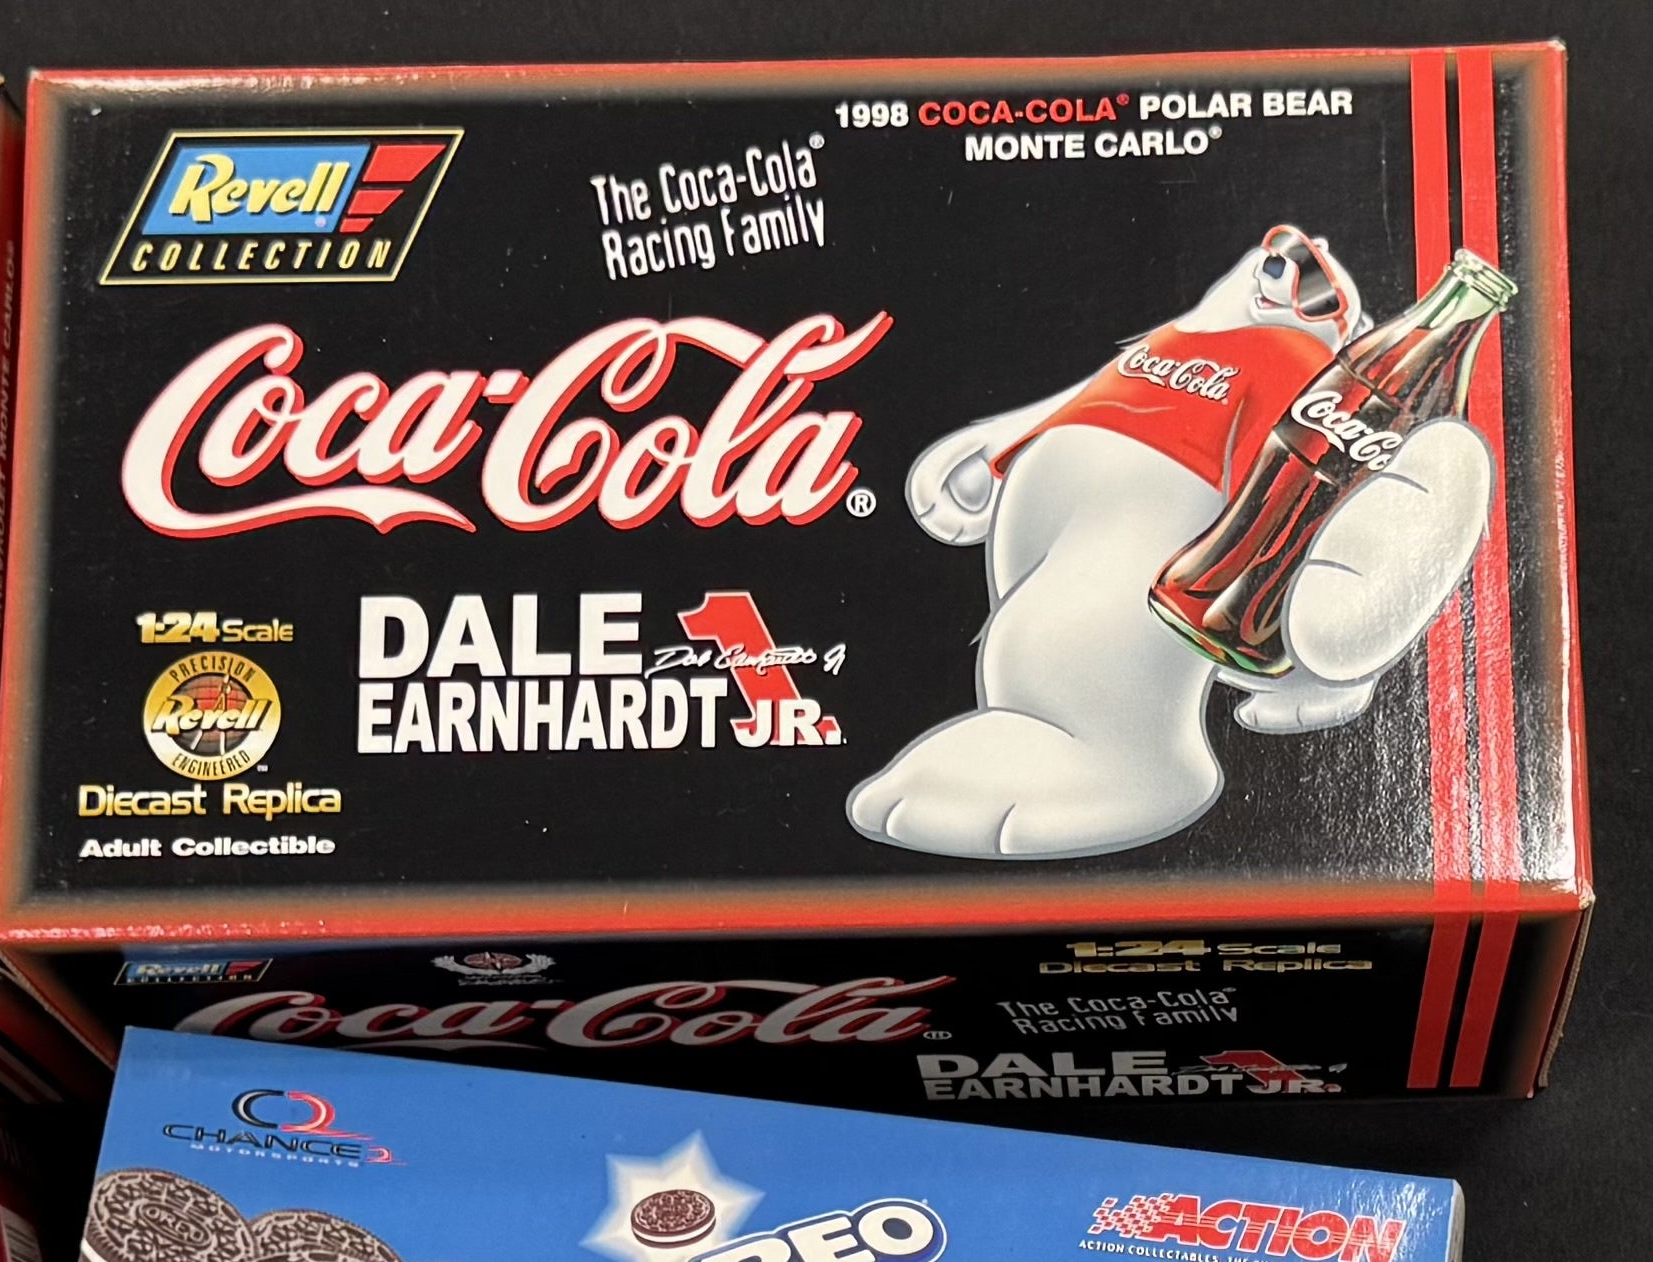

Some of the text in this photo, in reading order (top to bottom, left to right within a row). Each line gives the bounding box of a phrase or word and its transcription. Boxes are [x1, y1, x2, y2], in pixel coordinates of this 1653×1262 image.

[835, 101, 909, 129] 1998
[1138, 92, 1251, 120] POLAR
[1263, 89, 1353, 118] BEAR
[965, 132, 1085, 161] MONTE
[169, 154, 350, 222] Revell
[591, 174, 652, 227] The
[132, 239, 394, 272] COLLECTION
[603, 199, 825, 280] Racing Family
[1116, 345, 1240, 403] Coca-Cola
[121, 311, 893, 538] Coca-Cola
[1291, 390, 1404, 471] Coca-Co
[136, 612, 294, 644] 1:24 Scale
[357, 592, 644, 681] DALE
[170, 655, 256, 683] PRECISION
[154, 695, 265, 734] Revell
[357, 677, 728, 755] EARNHARDT
[173, 750, 252, 776] ENGINEERED
[78, 781, 341, 821] Diecast Replica
[79, 834, 336, 859] Adult Collectible
[1039, 959, 1372, 974] Diecast Replica
[1066, 940, 1341, 957] 1:24 Scale
[175, 975, 956, 1053] Coca-Cola
[997, 1000, 1054, 1019] The
[1012, 1005, 1237, 1035] Racing Family
[916, 1050, 1168, 1079] DALE
[923, 1074, 1241, 1100] EARNHARDT
[163, 1124, 362, 1160] CHANCE
[147, 1207, 208, 1245] OREO
[1079, 1240, 1124, 1253] ACTION
